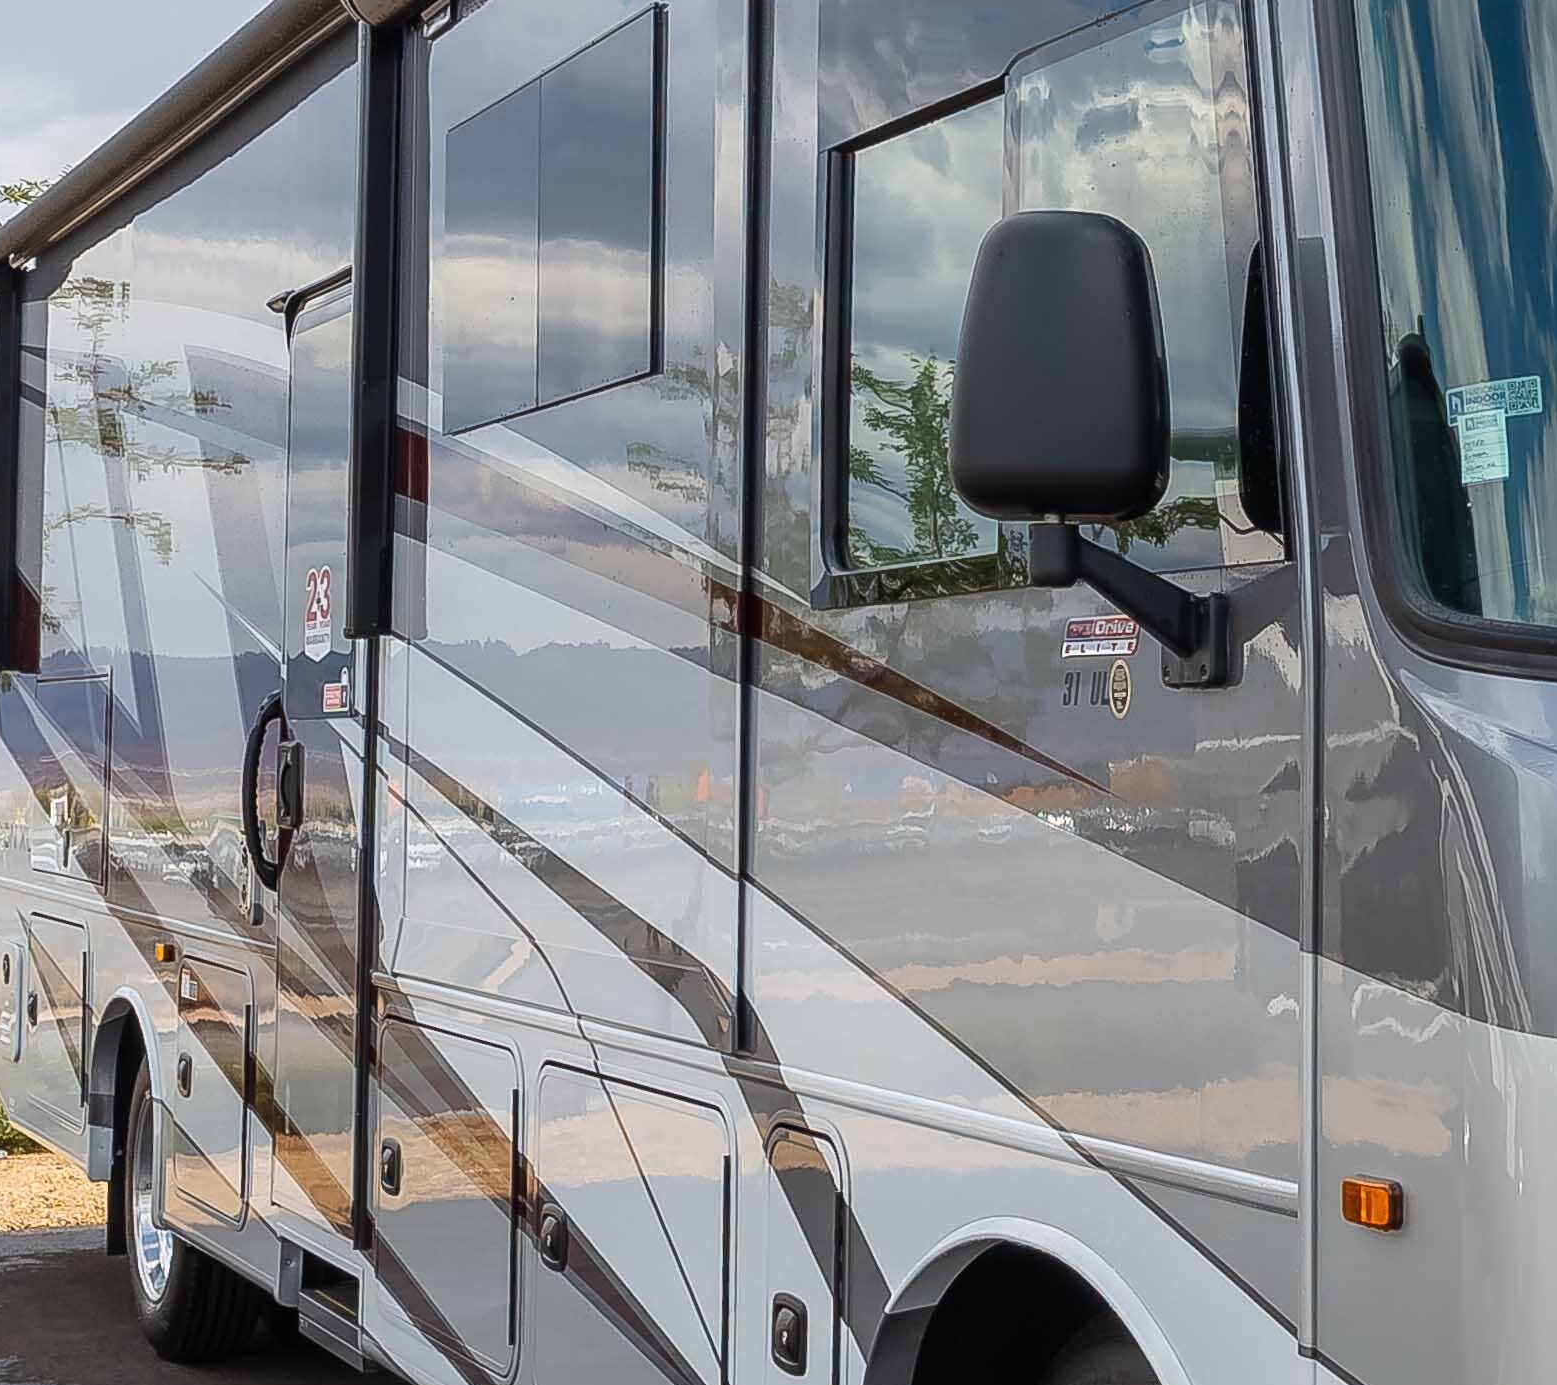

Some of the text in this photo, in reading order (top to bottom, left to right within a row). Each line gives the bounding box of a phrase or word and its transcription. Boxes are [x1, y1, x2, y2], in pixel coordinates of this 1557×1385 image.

[1095, 619, 1135, 636] Drive
[1065, 641, 1135, 654] ELITE
[1062, 671, 1082, 706] 31
